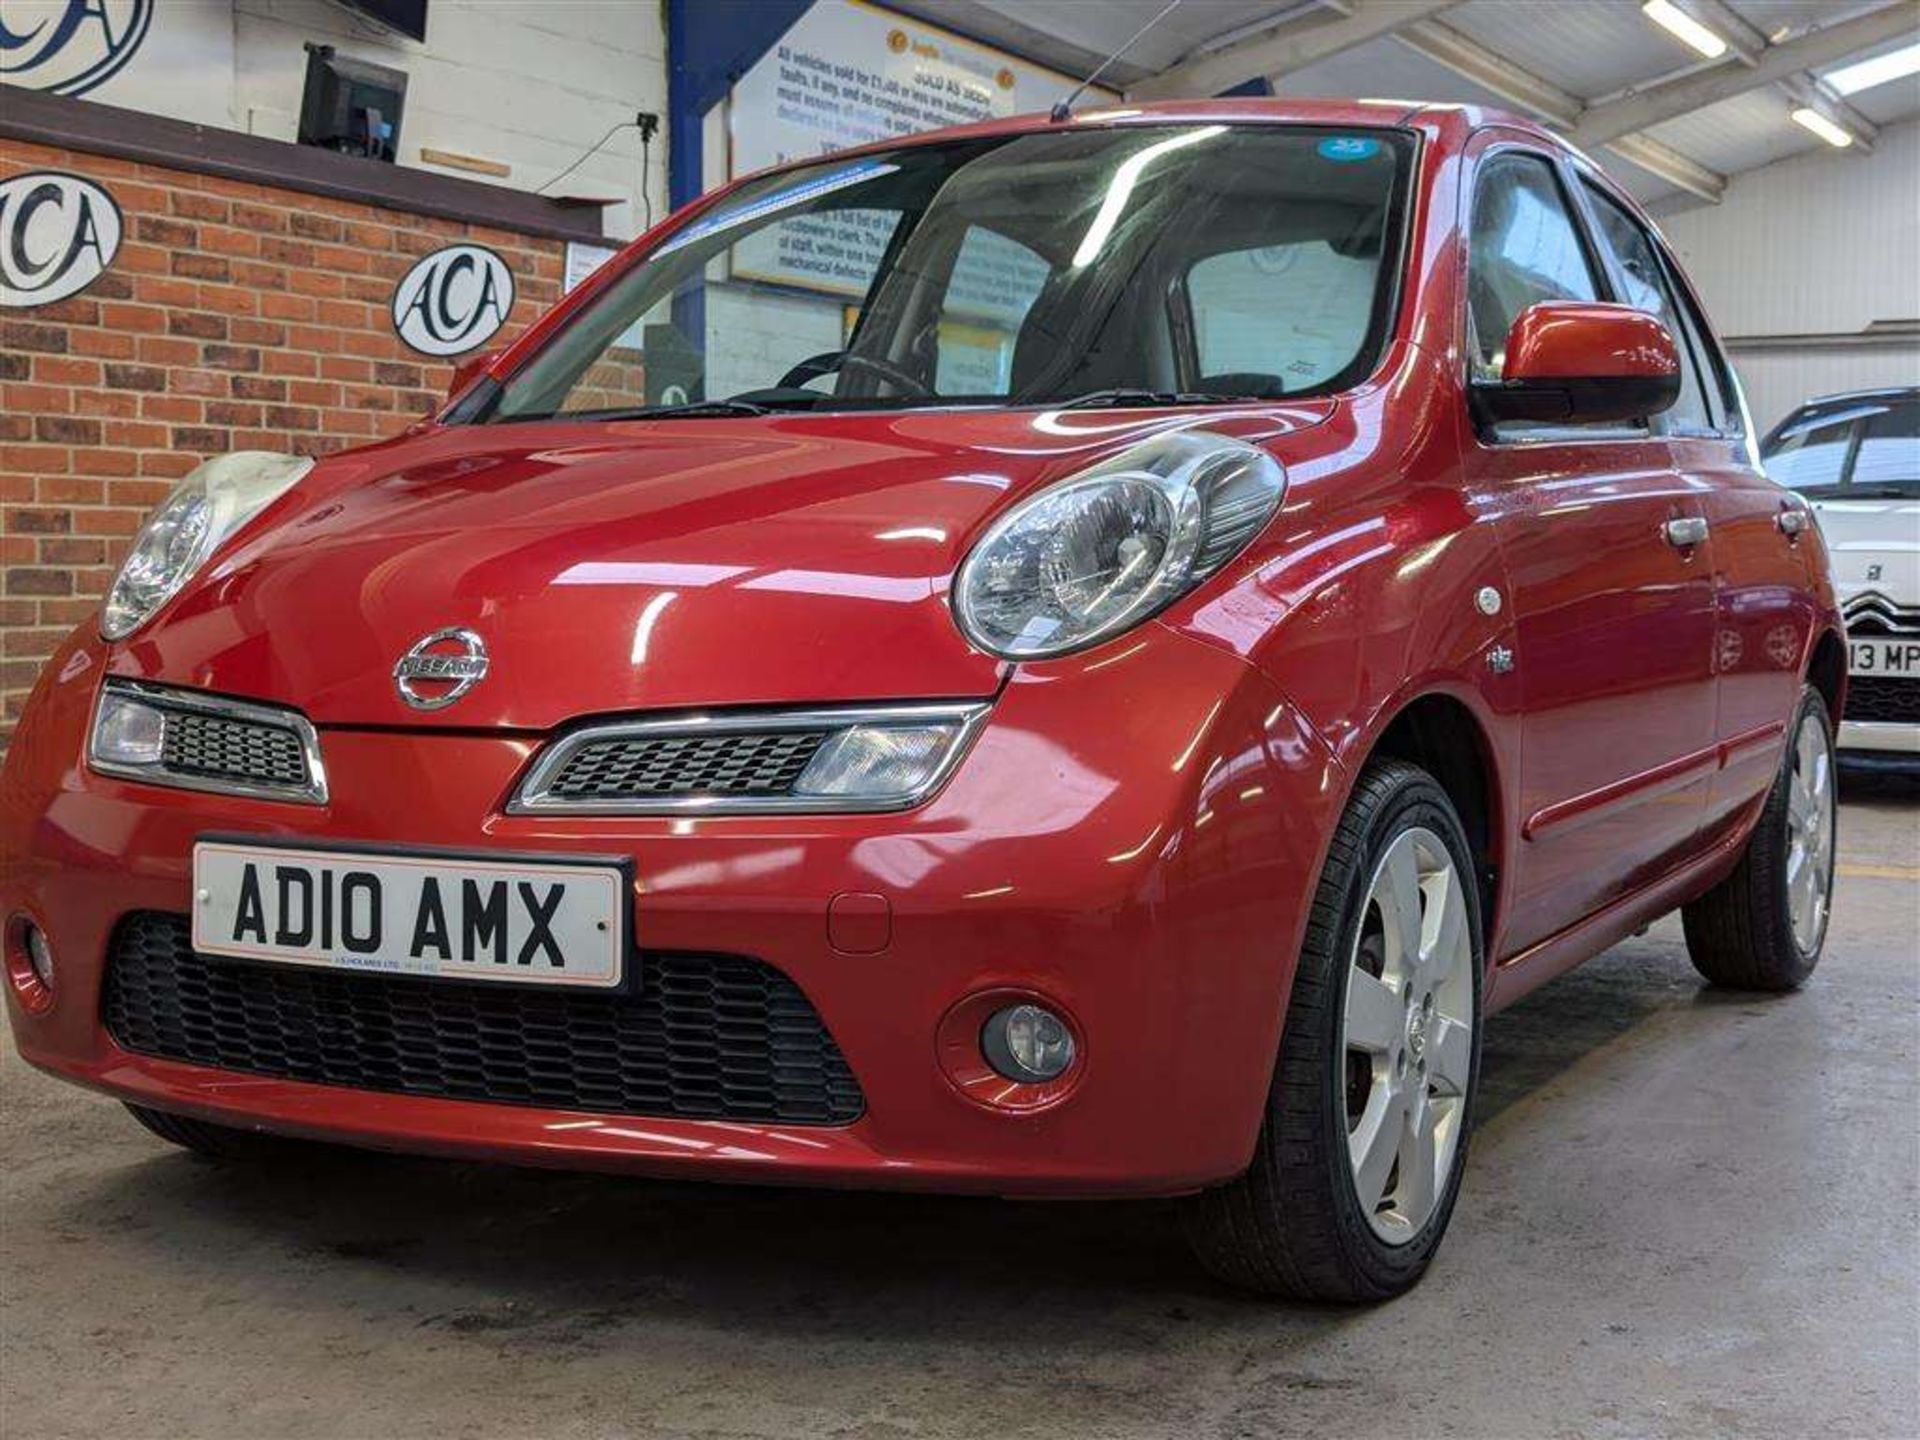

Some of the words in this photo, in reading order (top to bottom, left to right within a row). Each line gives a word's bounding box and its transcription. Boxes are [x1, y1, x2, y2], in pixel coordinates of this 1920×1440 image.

[793, 53, 832, 76] vehicles
[834, 66, 855, 82] sold
[399, 254, 502, 343] ACA
[410, 876, 566, 968] AMX
